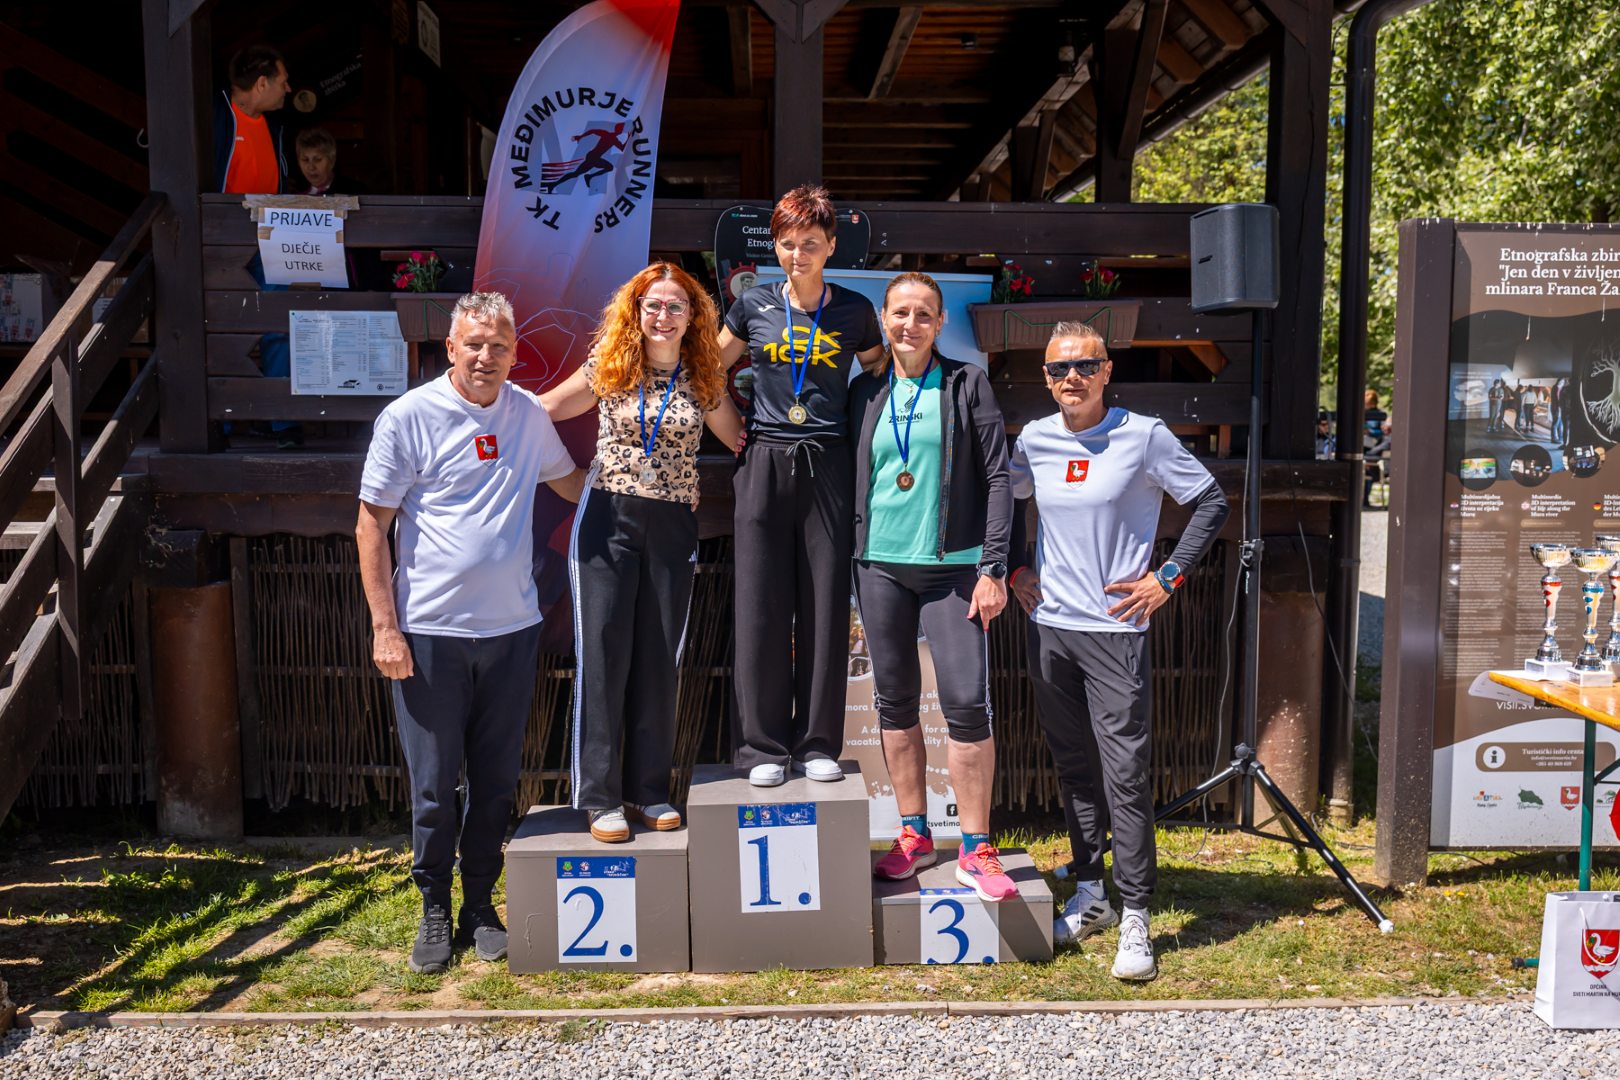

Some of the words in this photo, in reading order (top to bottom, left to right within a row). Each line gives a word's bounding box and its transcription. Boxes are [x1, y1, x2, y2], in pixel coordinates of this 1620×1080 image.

[525, 196, 561, 231] TK
[594, 115, 652, 233] RUNNERS
[270, 211, 333, 227] PRIJAVE
[281, 241, 322, 255] DJEČJE
[1500, 247, 1588, 265] Etnografska
[284, 261, 324, 272] UTRKE
[1499, 264, 1528, 282] "Jen
[1531, 264, 1560, 278] den
[1562, 268, 1571, 279] v
[1485, 282, 1543, 295] mlinara
[1547, 282, 1597, 296] Franca
[1600, 280, 1620, 296] Ža
[925, 724, 938, 733] for
[747, 835, 812, 906] 1.
[562, 885, 633, 957] 2.
[927, 898, 995, 964] 3.
